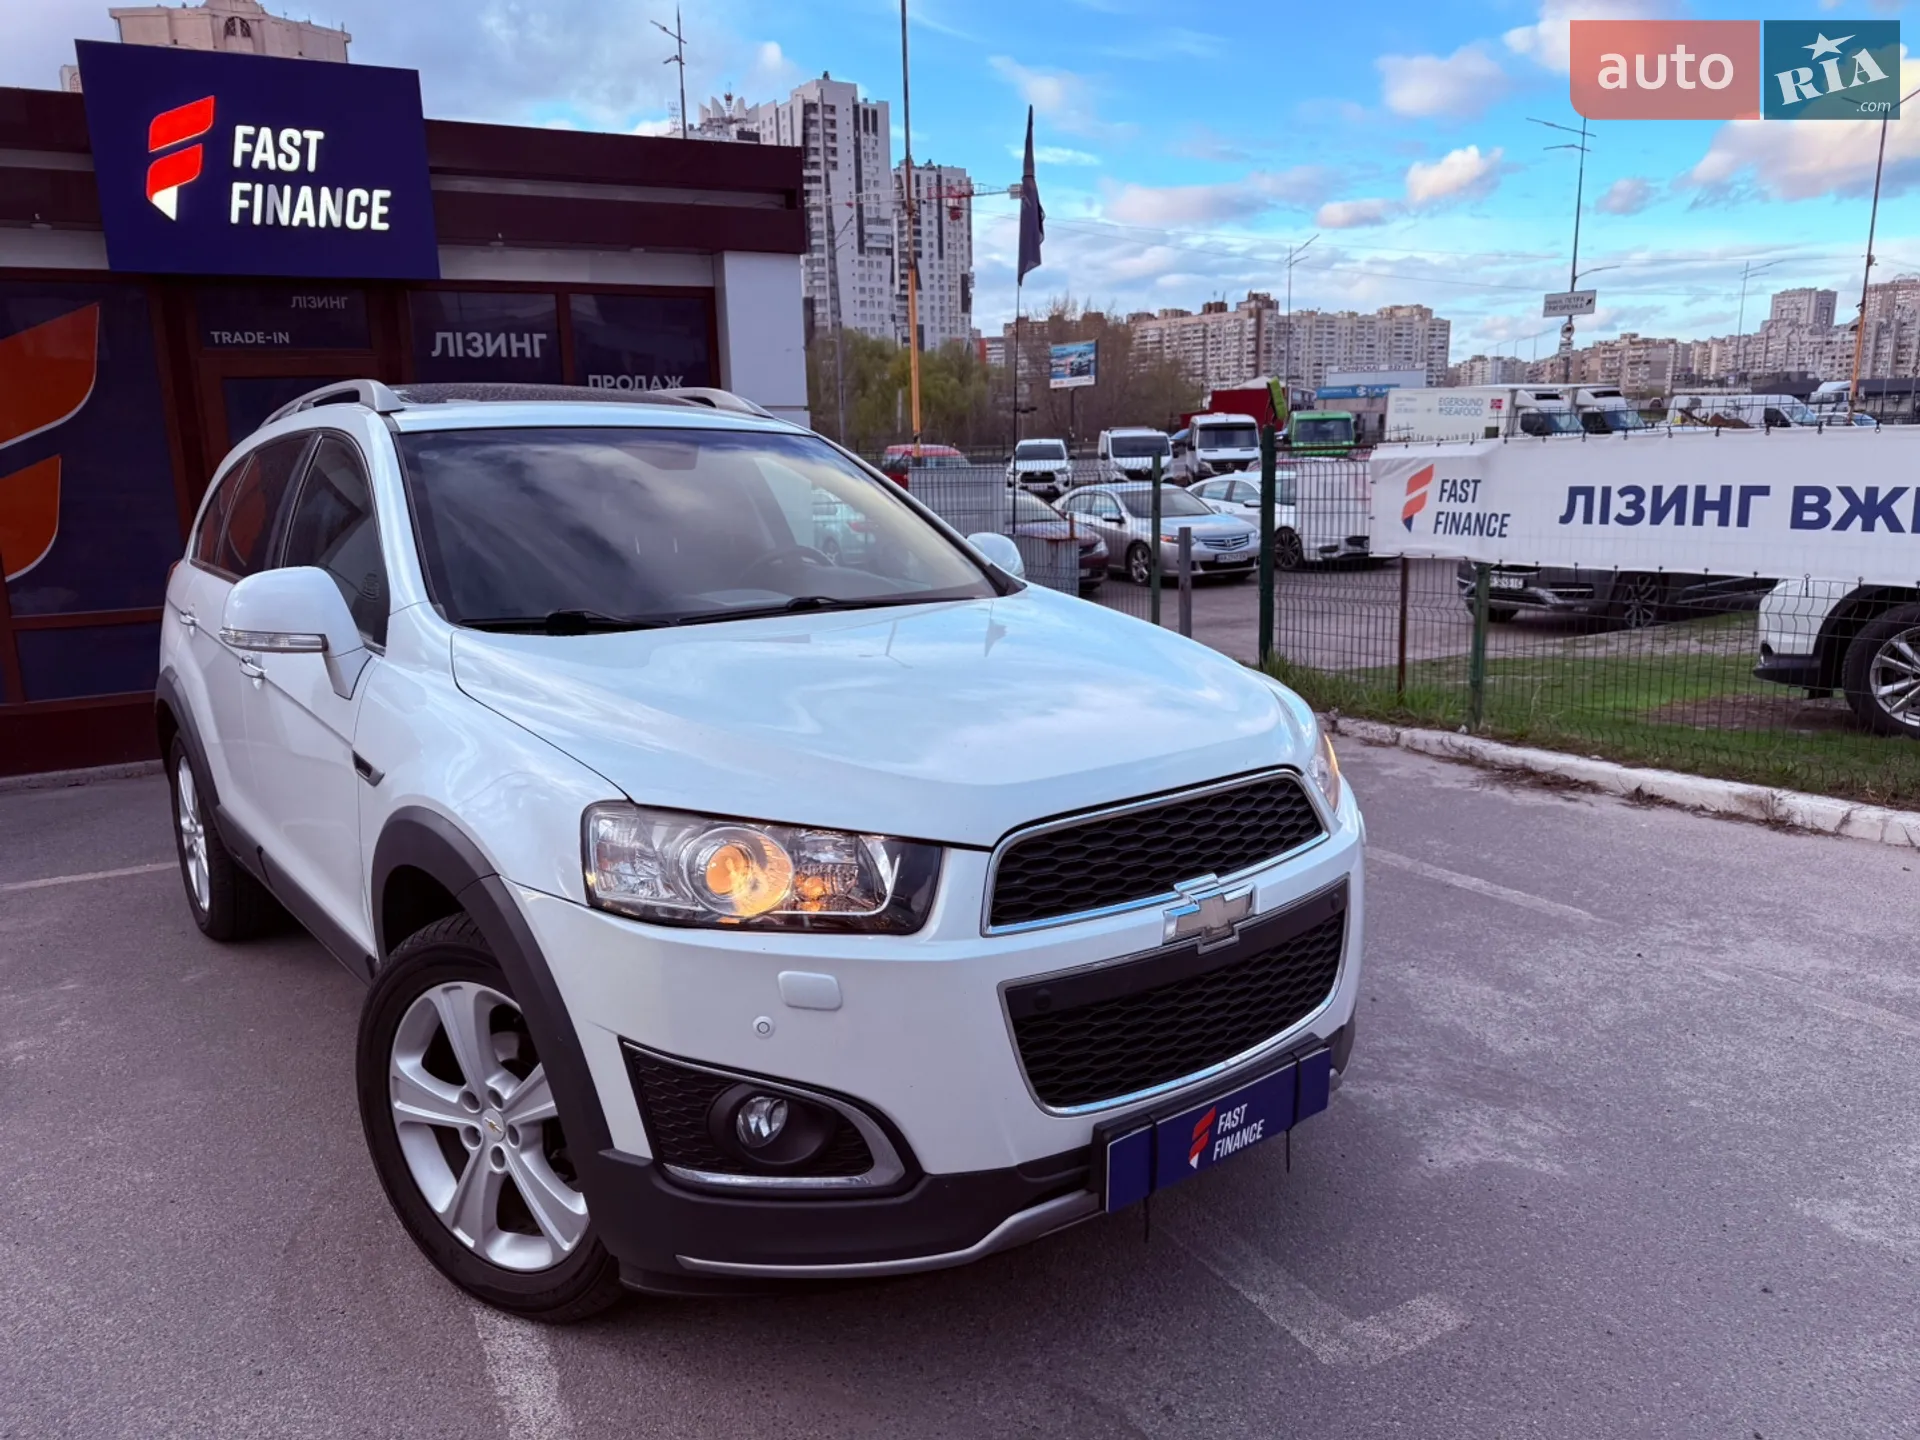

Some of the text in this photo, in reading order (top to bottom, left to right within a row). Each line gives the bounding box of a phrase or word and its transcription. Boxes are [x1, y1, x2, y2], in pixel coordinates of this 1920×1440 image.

[233, 125, 325, 172] FAST
[230, 182, 392, 231] FINANCE
[290, 295, 348, 310] ЛІЗИНГ
[210, 331, 291, 344] TRADE-IN
[431, 331, 547, 358] ЛІЗИНГ
[588, 374, 684, 391] ПРОДАЖ
[1438, 397, 1484, 407] EGERSUND
[1438, 479, 1481, 503] FAST
[1559, 485, 1771, 528] ЛІЗИНГ
[1433, 511, 1511, 538] FINANCE
[1217, 1103, 1248, 1135] FAST
[1213, 1119, 1265, 1161] FINANCE
